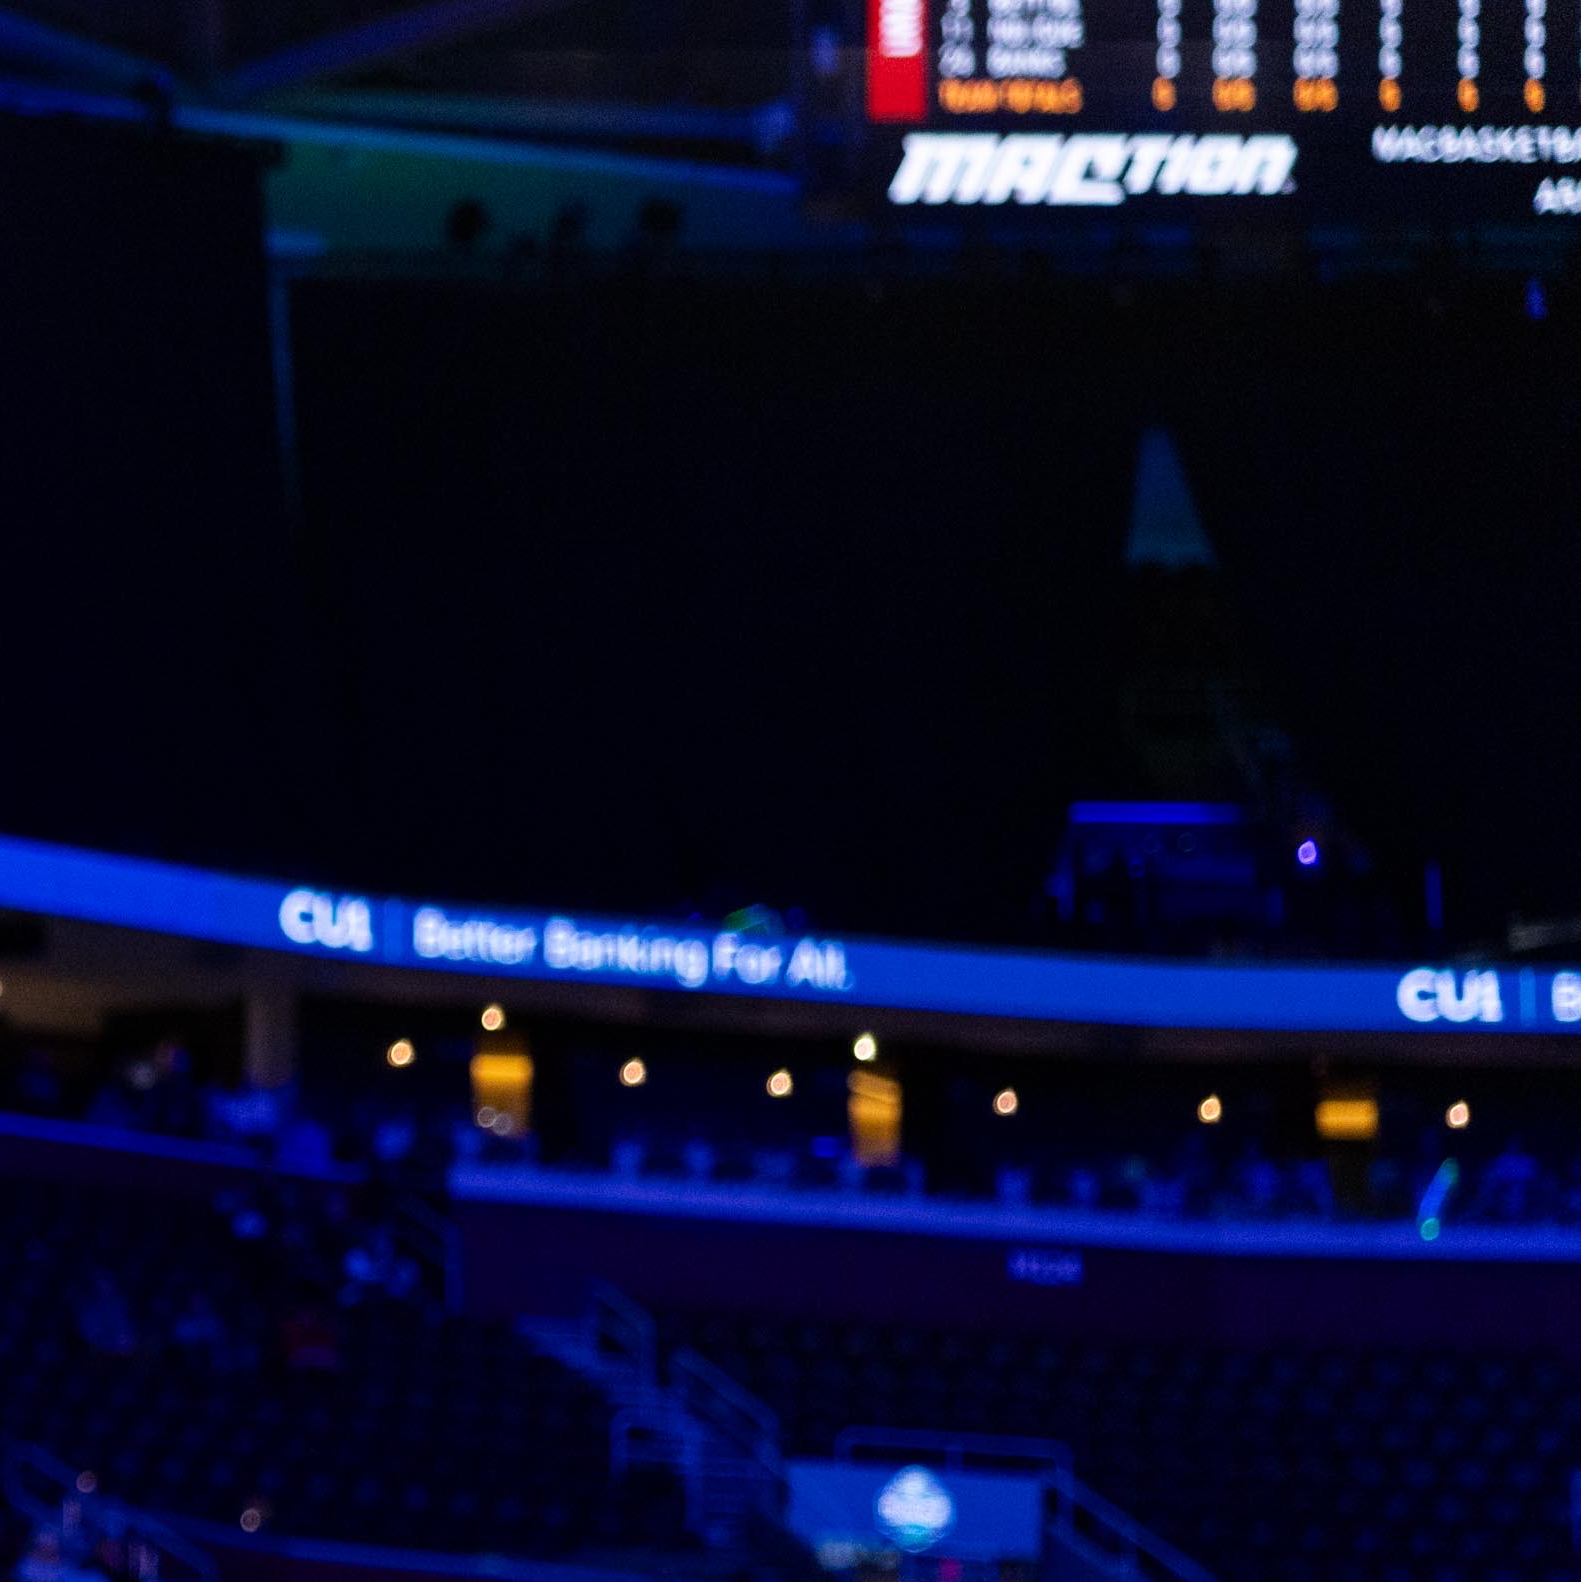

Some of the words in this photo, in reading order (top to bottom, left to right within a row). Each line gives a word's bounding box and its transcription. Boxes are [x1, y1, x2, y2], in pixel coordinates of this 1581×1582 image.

[413, 907, 537, 965] Better
[543, 917, 707, 988] Banking
[712, 932, 782, 985] For
